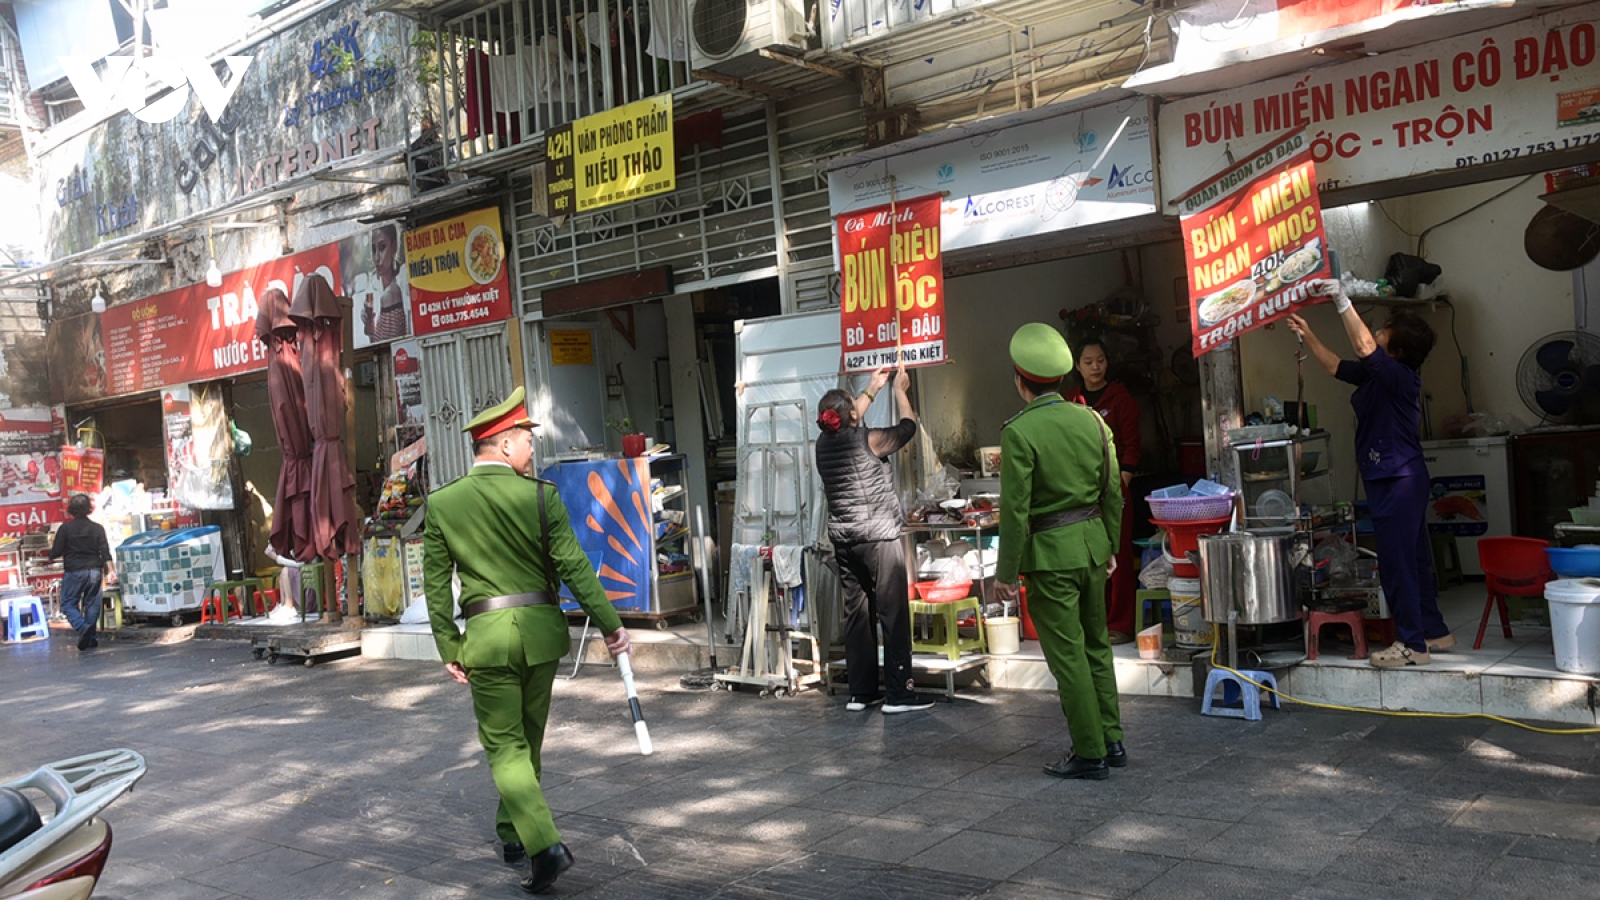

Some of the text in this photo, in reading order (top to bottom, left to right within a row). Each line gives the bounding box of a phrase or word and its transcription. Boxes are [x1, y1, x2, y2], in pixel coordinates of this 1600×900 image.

[1184, 23, 1596, 148] BÚN MIẾN NGAN CÔ ĐẠO
[547, 130, 572, 160] 42H
[577, 103, 668, 155] VĂN PHÒNG PHẨM
[1309, 129, 1361, 164] ỚC
[1392, 104, 1493, 147] TRỘN
[1526, 141, 1557, 156] 753
[584, 142, 663, 188] HIẾU THẢO
[1219, 163, 1253, 192] NGON
[448, 221, 468, 241] CUA
[844, 217, 866, 233] Cô
[1191, 210, 1237, 260] BÚN
[1252, 165, 1313, 225] MIẾN
[844, 222, 938, 313] BÚN RIÊU
[1194, 242, 1251, 291] NGAN
[1268, 205, 1317, 254] MỌC
[207, 281, 259, 330] TRÀ
[897, 266, 937, 312] ỐC
[846, 323, 865, 347] BÒ
[877, 317, 898, 343] GIÒ
[911, 313, 941, 341] ĐẬU
[1198, 277, 1325, 350] TRỘN NƯỚC
[213, 340, 249, 369] NƯỚC
[920, 344, 940, 361] KIỆT
[6, 507, 47, 527] GIẢI
